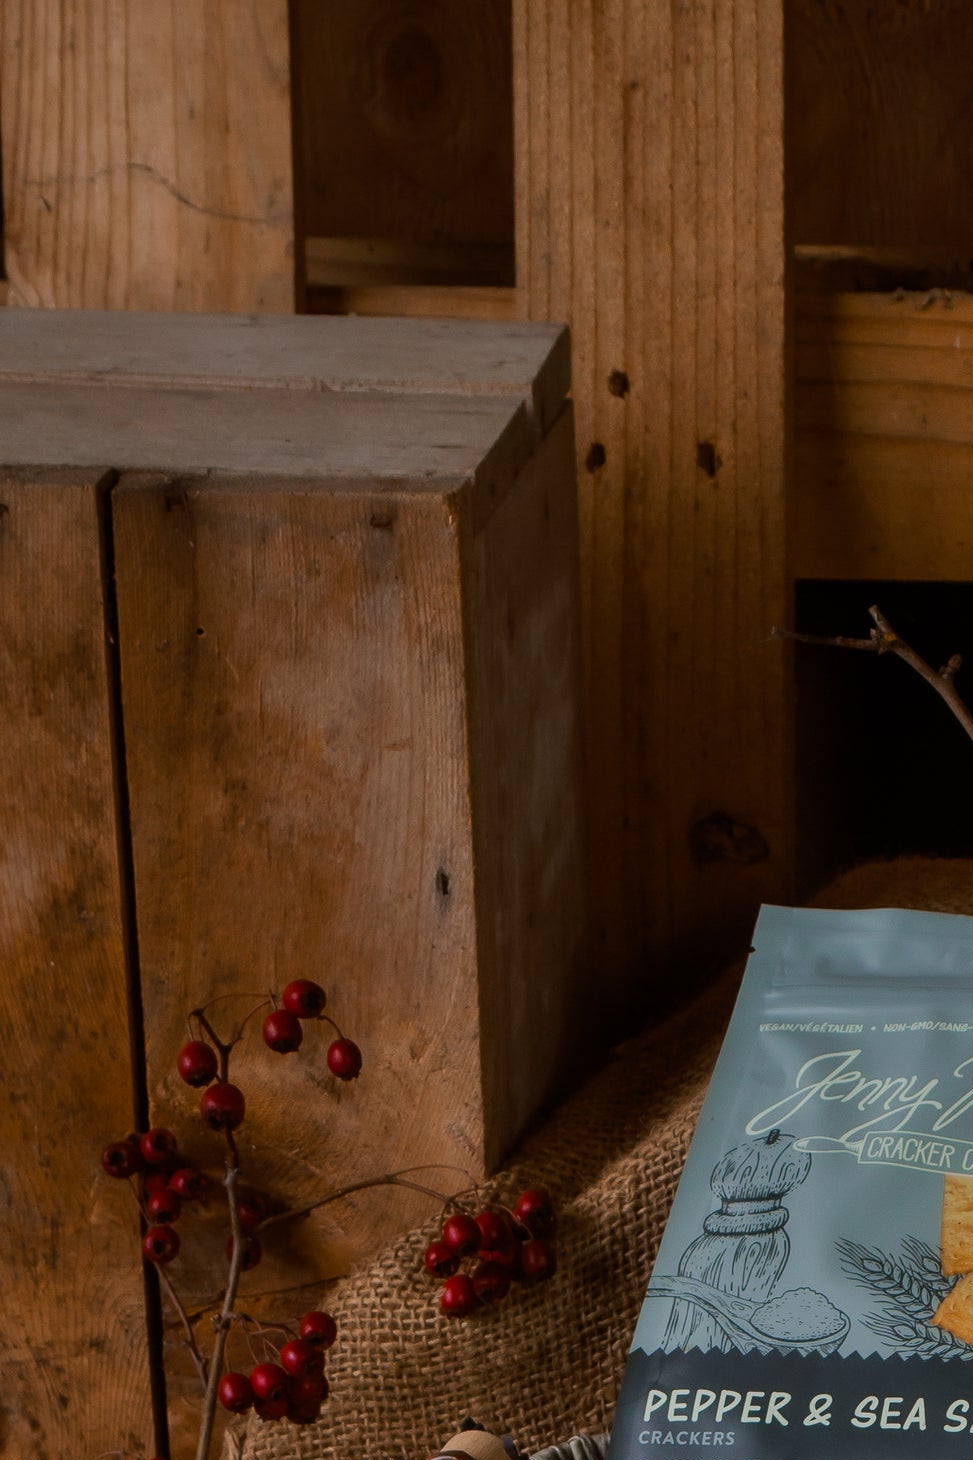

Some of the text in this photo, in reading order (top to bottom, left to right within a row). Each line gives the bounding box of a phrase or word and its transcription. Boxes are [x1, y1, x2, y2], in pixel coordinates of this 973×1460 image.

[759, 1022, 864, 1033] VEGAN/VÉGÉTALIEN
[745, 1048, 941, 1140] Jenny
[867, 1137, 954, 1169] CRACKER
[643, 1389, 792, 1427] PEPPER
[803, 1393, 834, 1428] &
[850, 1395, 927, 1432] SEA
[638, 1430, 736, 1447] CRACKERS
